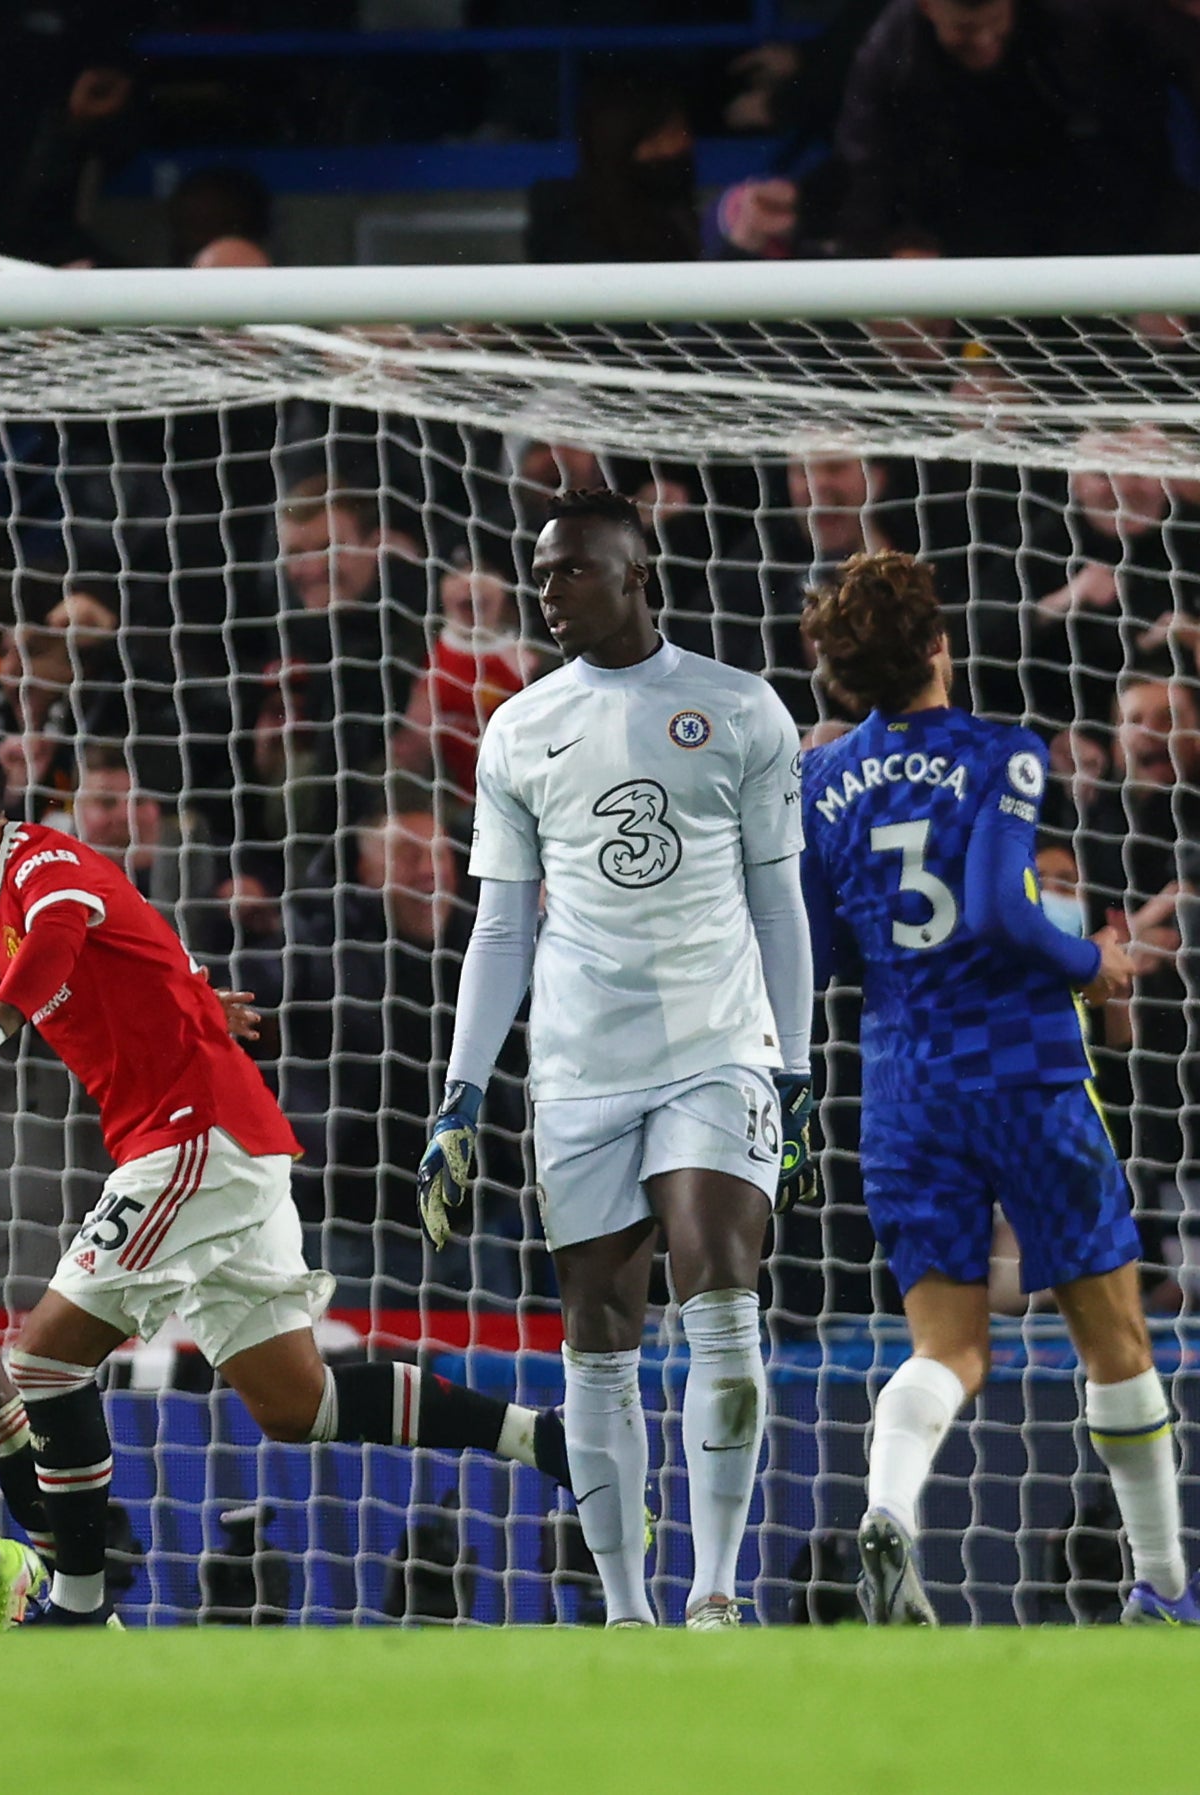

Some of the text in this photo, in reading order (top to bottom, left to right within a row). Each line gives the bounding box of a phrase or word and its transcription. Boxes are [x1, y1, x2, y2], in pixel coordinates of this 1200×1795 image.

[592, 778, 682, 889] 3
[815, 752, 968, 824] MARCOSA
[870, 818, 958, 949] 3
